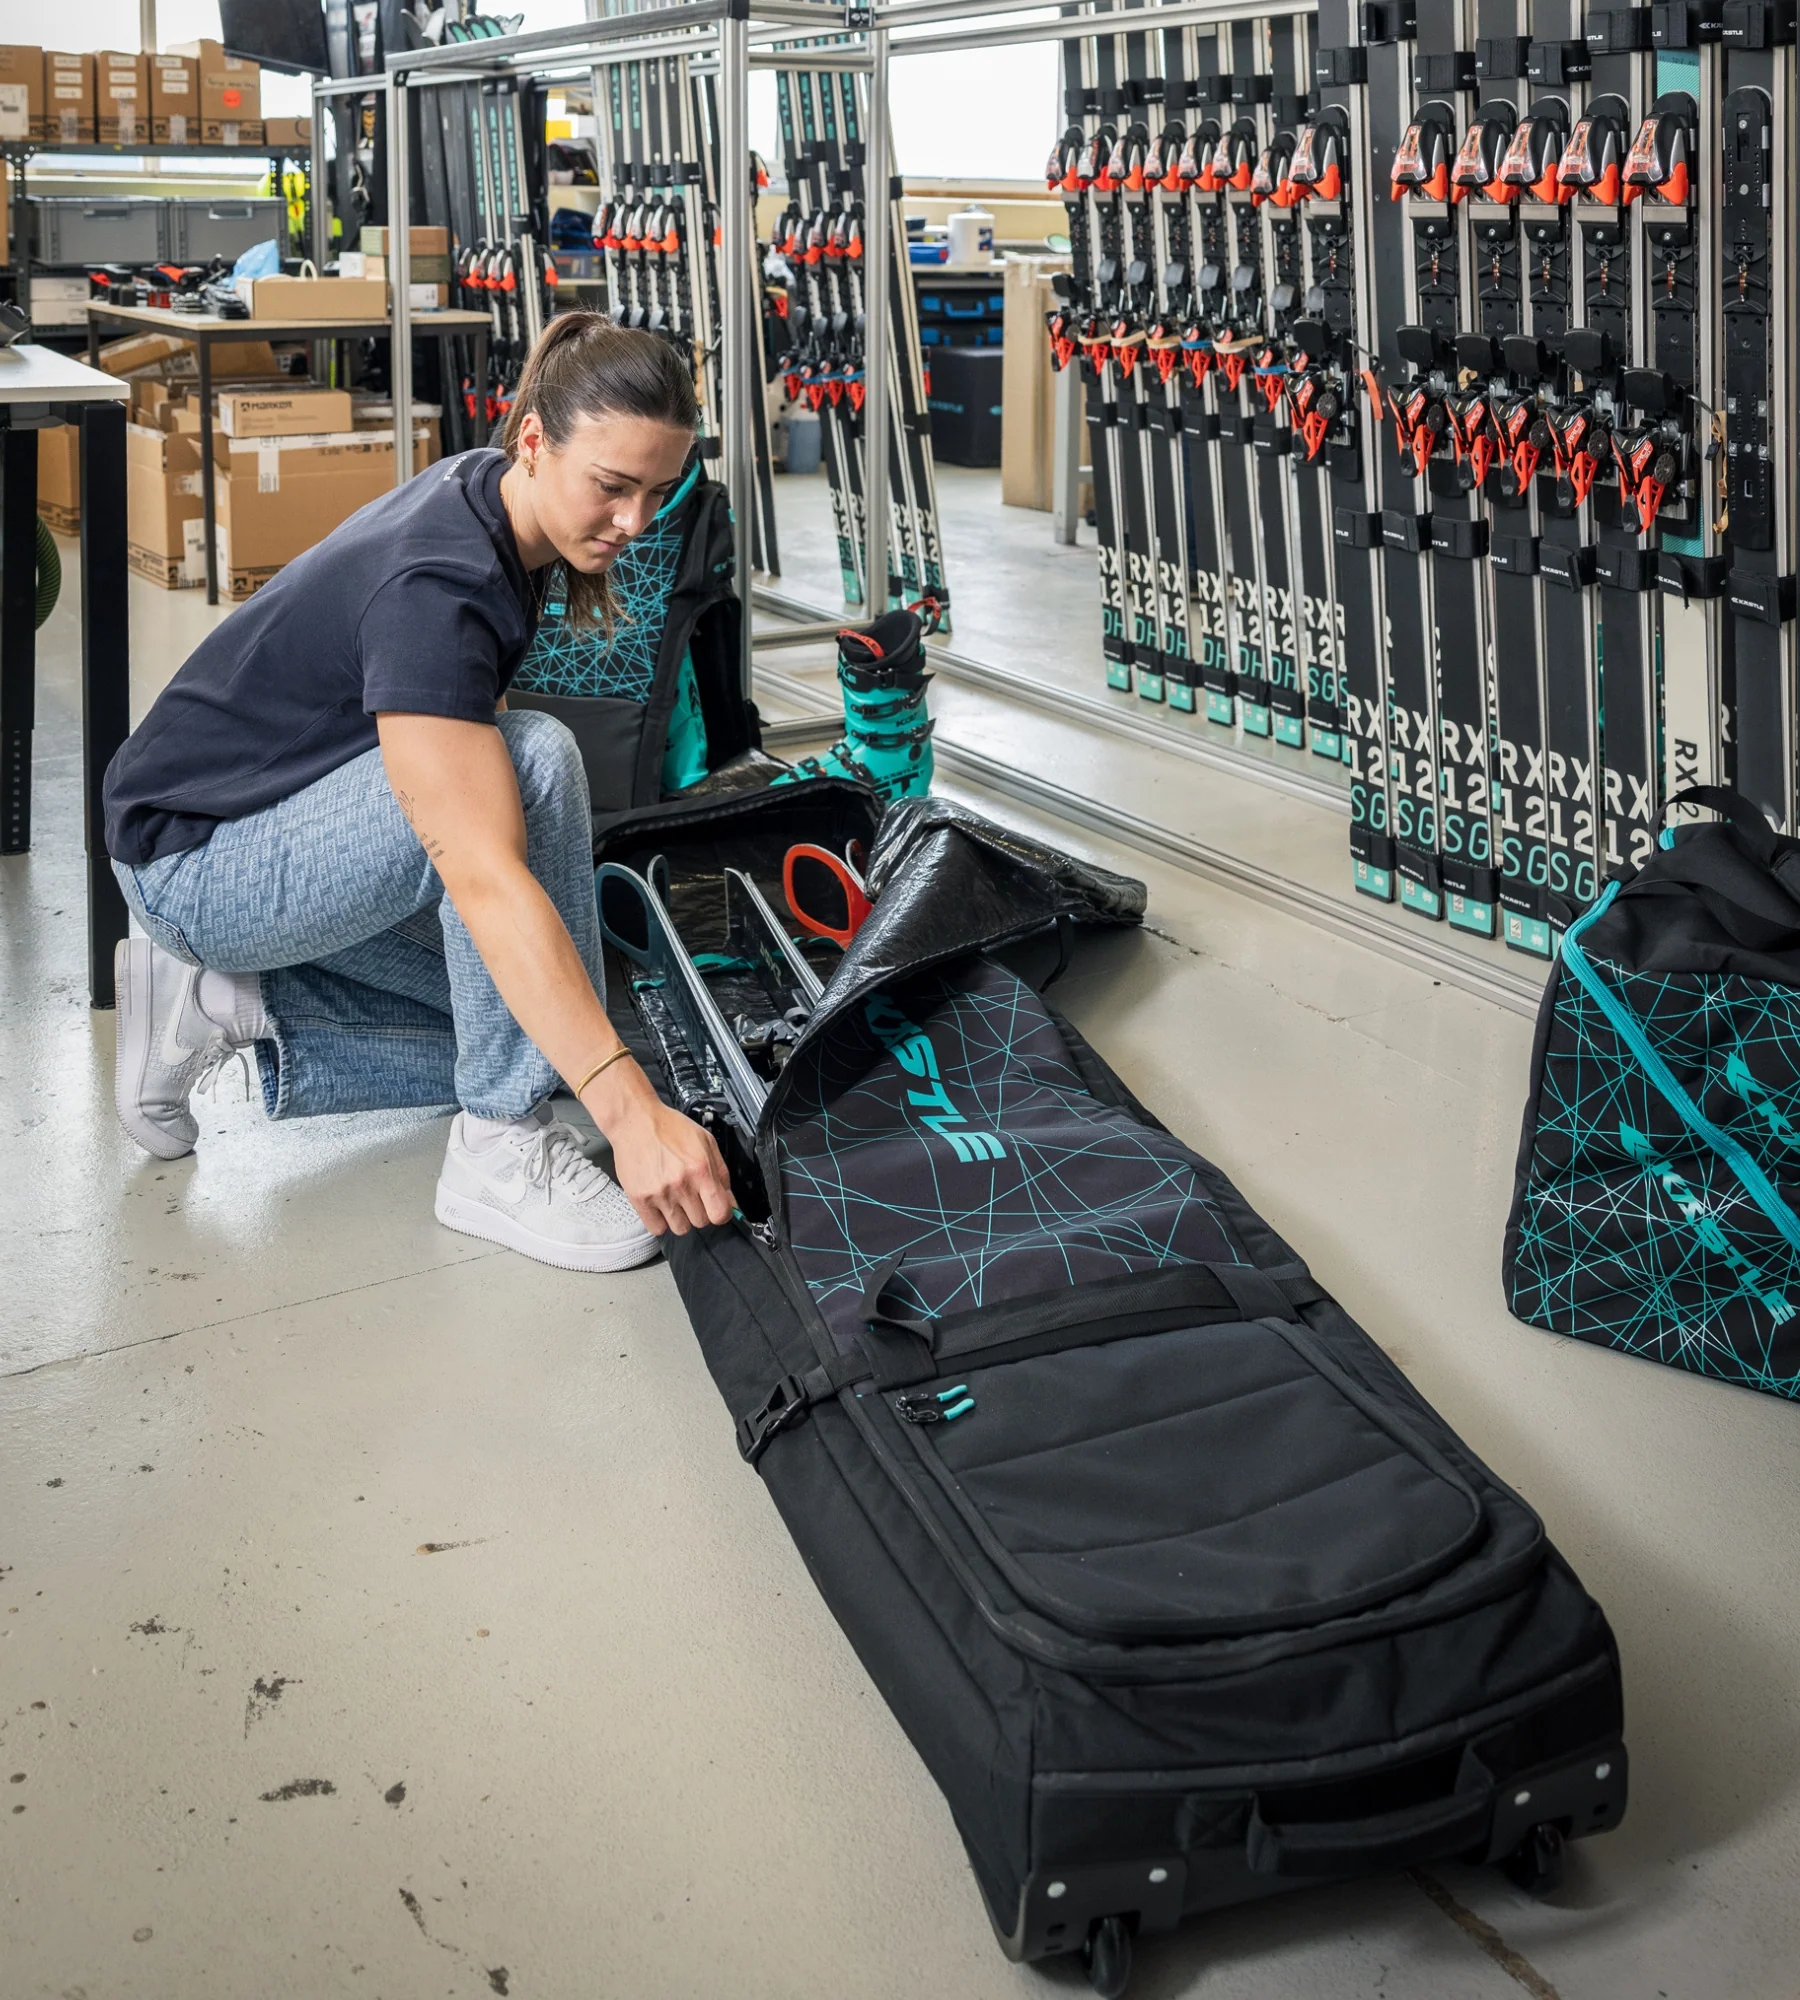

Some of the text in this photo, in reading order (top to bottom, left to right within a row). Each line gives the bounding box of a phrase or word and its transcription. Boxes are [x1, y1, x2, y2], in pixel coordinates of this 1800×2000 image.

[1566, 421, 1584, 443] RACE
[1633, 444, 1651, 468] RACE
[1097, 544, 1120, 575] RX
[1129, 551, 1154, 584] RX
[1159, 561, 1184, 593] RX
[1100, 576, 1121, 608] 12
[1131, 584, 1156, 617] 12
[1197, 569, 1222, 603] RX
[1232, 576, 1259, 611] RX
[1265, 585, 1292, 620] RX
[1103, 608, 1124, 639] DH
[1160, 594, 1186, 628] 12
[1200, 603, 1226, 638] 12
[1236, 611, 1262, 647] 12
[1303, 595, 1331, 632] RX
[1135, 617, 1159, 650] DH
[1165, 627, 1189, 659] DH
[1267, 620, 1295, 657] 12
[1304, 630, 1333, 668] 12
[1203, 638, 1228, 671] DH
[1239, 646, 1265, 680] DH
[1271, 656, 1298, 690] DH
[1308, 667, 1335, 702] SG
[1347, 694, 1382, 742] RX
[1394, 705, 1431, 755] RX
[1442, 719, 1484, 768] RX
[1346, 738, 1384, 787] 12
[1395, 752, 1433, 801] 12
[1500, 739, 1544, 791] RX
[1549, 750, 1592, 806] RX
[1351, 784, 1386, 830] SG
[1443, 766, 1487, 816] 12
[1604, 767, 1649, 824] RX
[1398, 799, 1435, 845] SG
[1501, 788, 1546, 840] 12
[1550, 801, 1594, 856] 12
[1445, 814, 1489, 860] SG
[1605, 818, 1653, 871] 12
[1502, 837, 1547, 885] SG
[1551, 852, 1595, 902] SG
